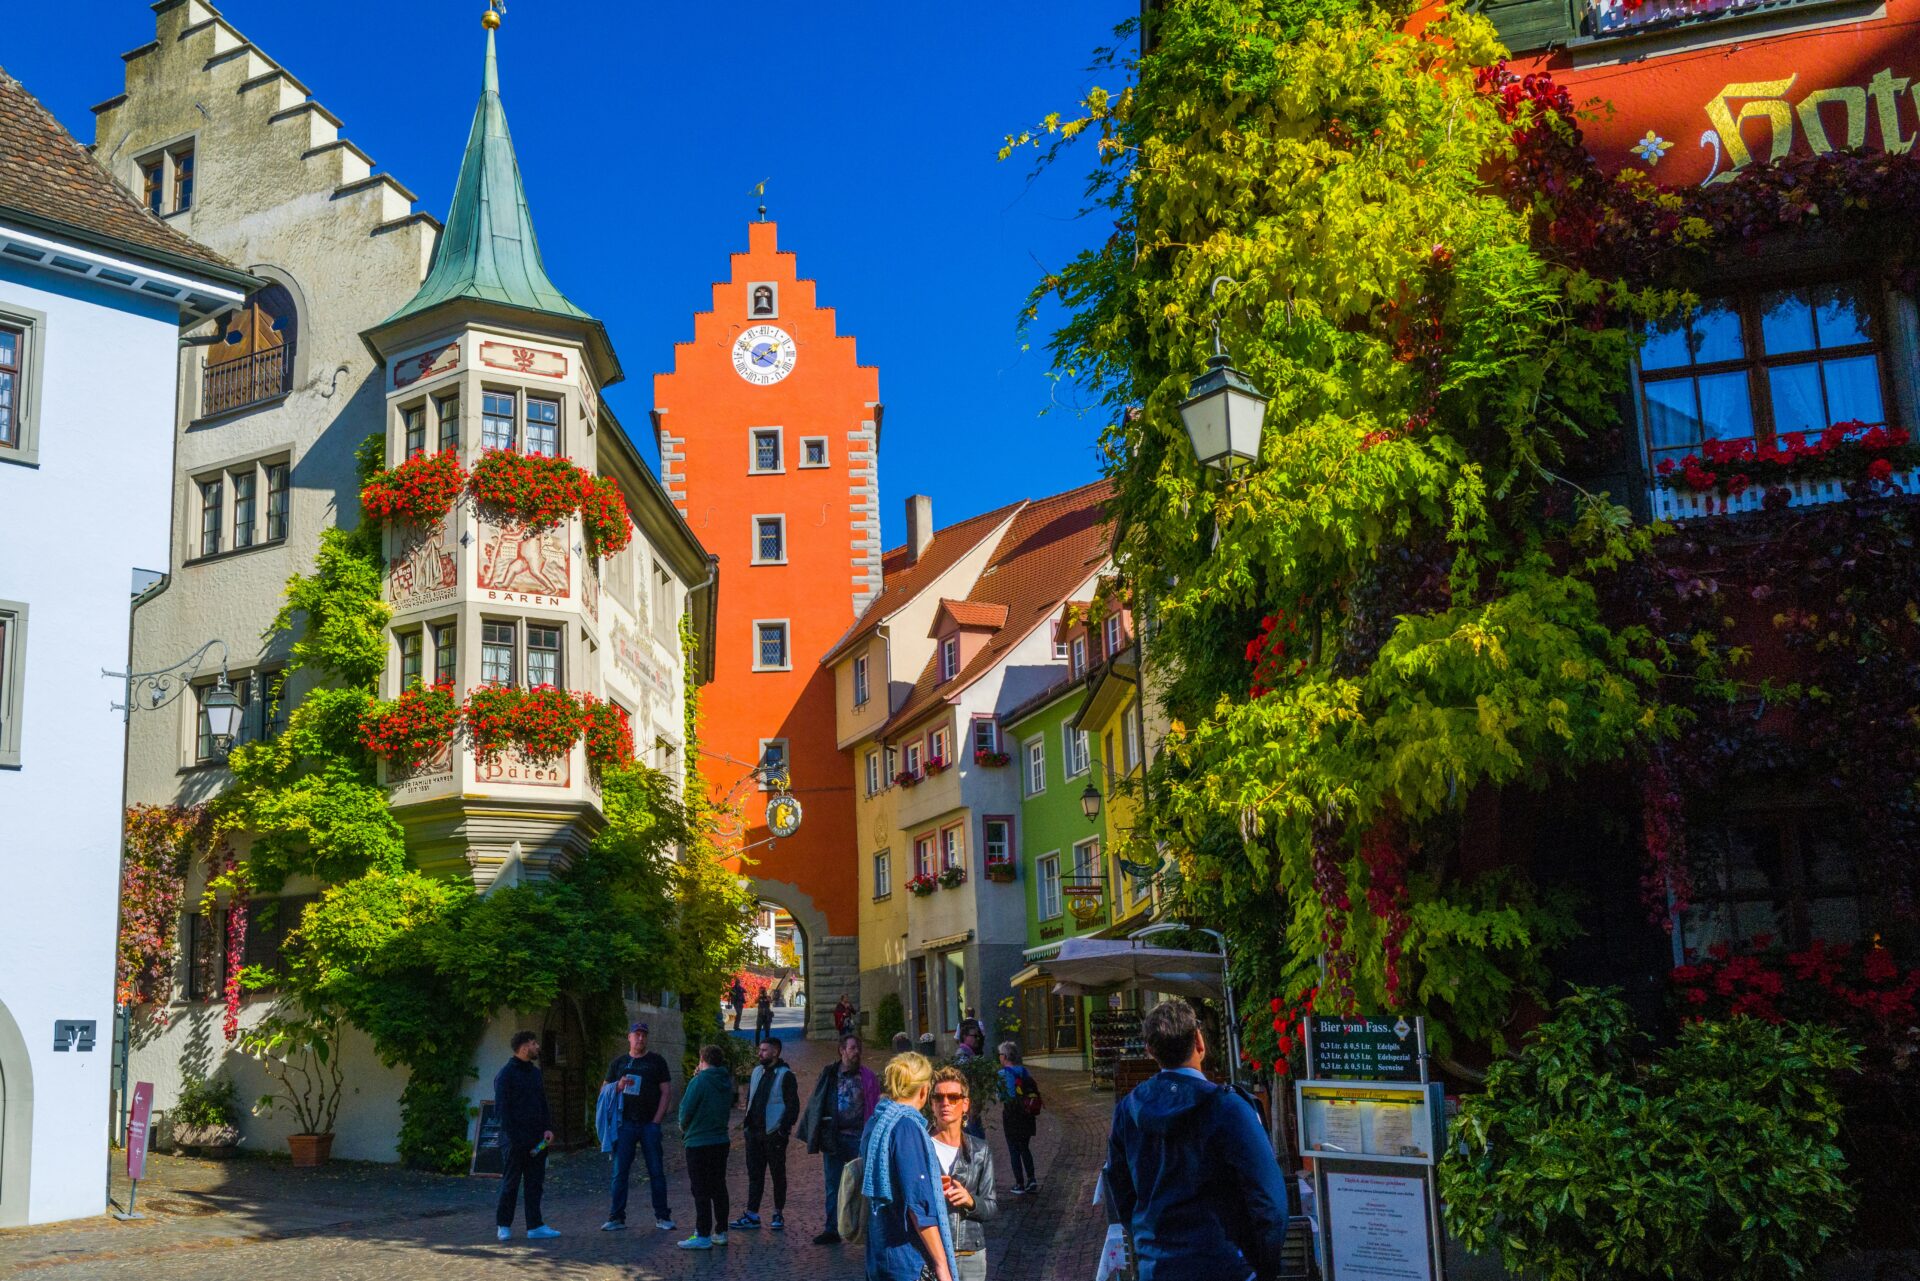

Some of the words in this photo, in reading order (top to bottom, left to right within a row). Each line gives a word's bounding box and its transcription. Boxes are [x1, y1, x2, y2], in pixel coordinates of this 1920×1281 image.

[488, 590, 559, 606] BÄREN
[486, 750, 557, 781] Bären
[1320, 1021, 1340, 1032] Bier
[1365, 1021, 1391, 1032] Fass.
